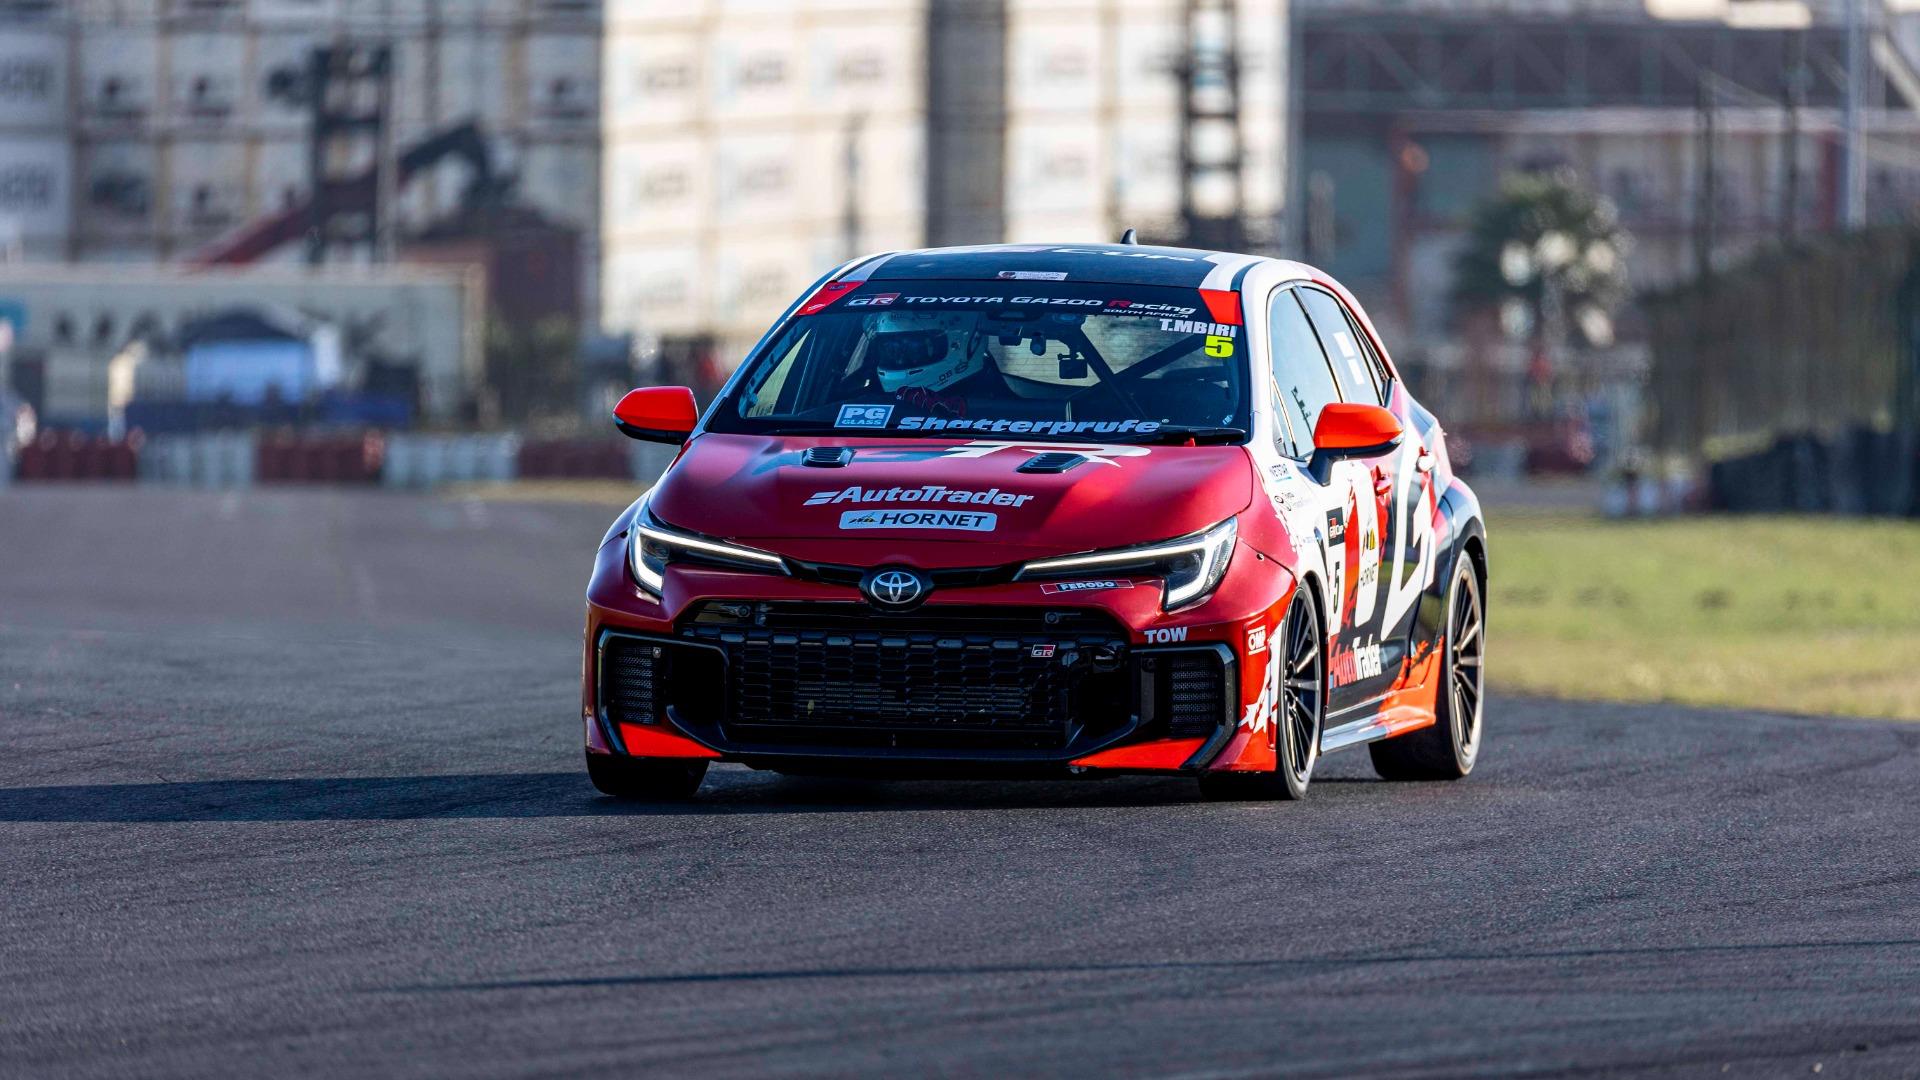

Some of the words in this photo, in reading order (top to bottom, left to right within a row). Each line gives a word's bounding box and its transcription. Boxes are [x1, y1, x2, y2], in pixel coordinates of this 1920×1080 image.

[848, 297, 893, 306] GR
[904, 296, 1004, 304] TOYOTA
[1010, 296, 1103, 307] GAZOO
[1108, 299, 1196, 315] Racing
[1145, 310, 1189, 319] AFRICA
[1159, 318, 1238, 338] T.MBIRI
[1204, 335, 1235, 358] 5
[843, 407, 886, 420] PG
[897, 416, 1160, 435] Shatterprufe
[832, 485, 1035, 508] AutoTrader
[879, 512, 988, 528] HORNET
[1060, 581, 1115, 591] FERODO
[1333, 560, 1341, 614] 5
[1143, 626, 1188, 644] TOW
[1333, 633, 1382, 688] AutoTrader
